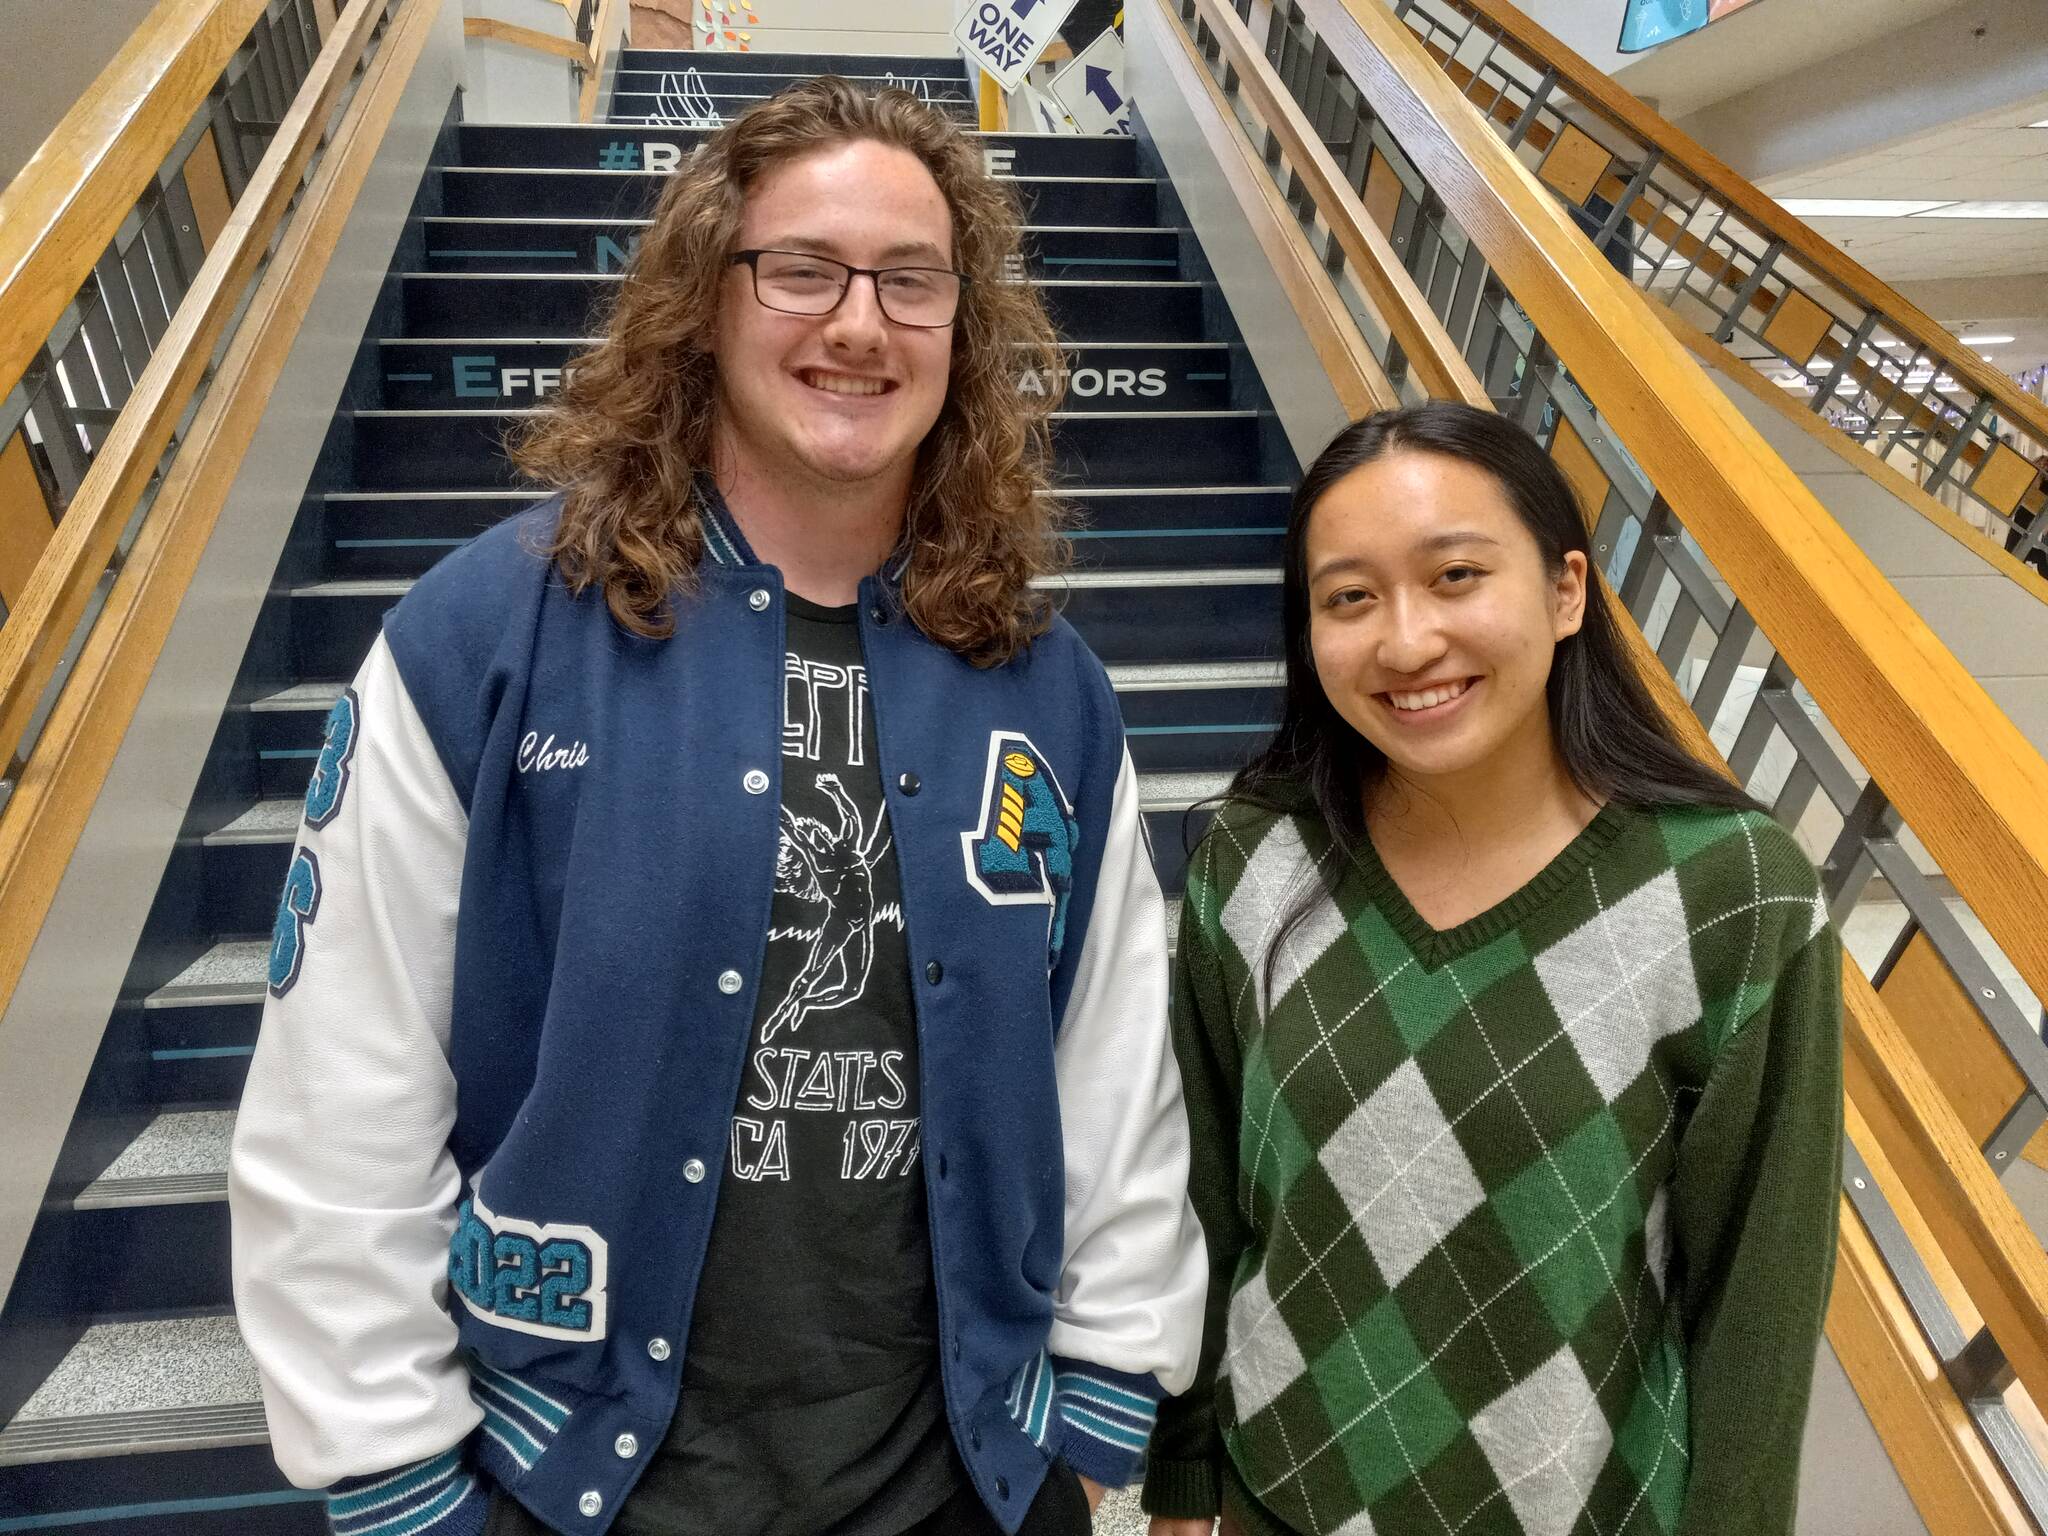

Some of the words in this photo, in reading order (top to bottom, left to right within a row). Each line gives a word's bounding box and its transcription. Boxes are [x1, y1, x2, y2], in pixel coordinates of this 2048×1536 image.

[968, 19, 1022, 72] WAY
[979, 3, 1035, 58] ONE
[599, 142, 710, 171] #R
[517, 731, 590, 773] Chris
[747, 1047, 907, 1113] STATES
[839, 1116, 922, 1180] 1977
